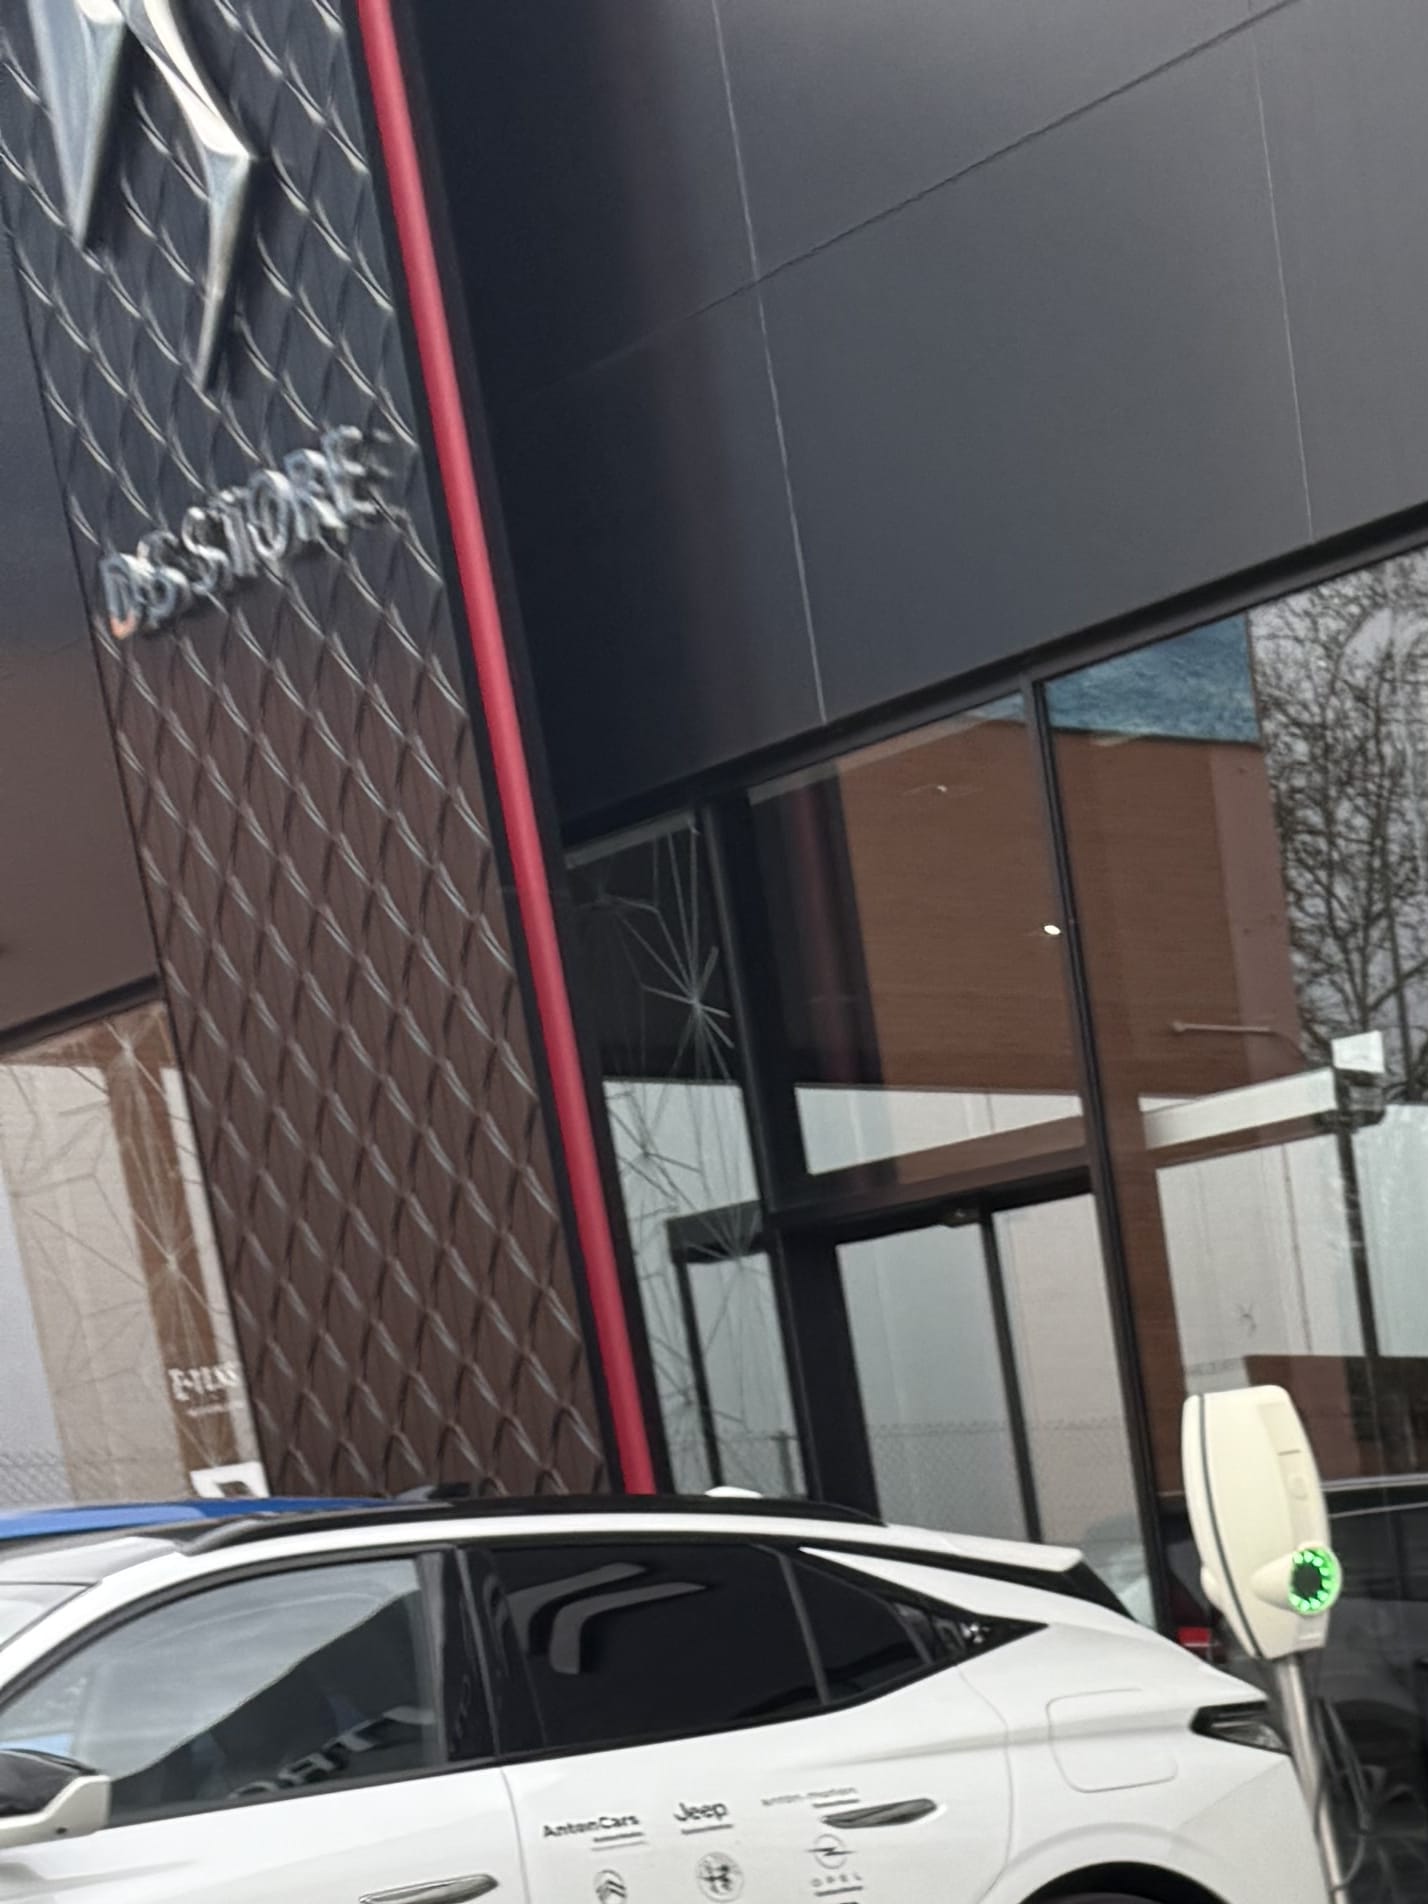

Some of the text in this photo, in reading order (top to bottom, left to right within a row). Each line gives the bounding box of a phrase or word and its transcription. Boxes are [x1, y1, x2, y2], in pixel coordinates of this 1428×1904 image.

[181, 424, 380, 593] STORE
[673, 1802, 727, 1822] Jeep
[543, 1815, 640, 1838] AntonCars
